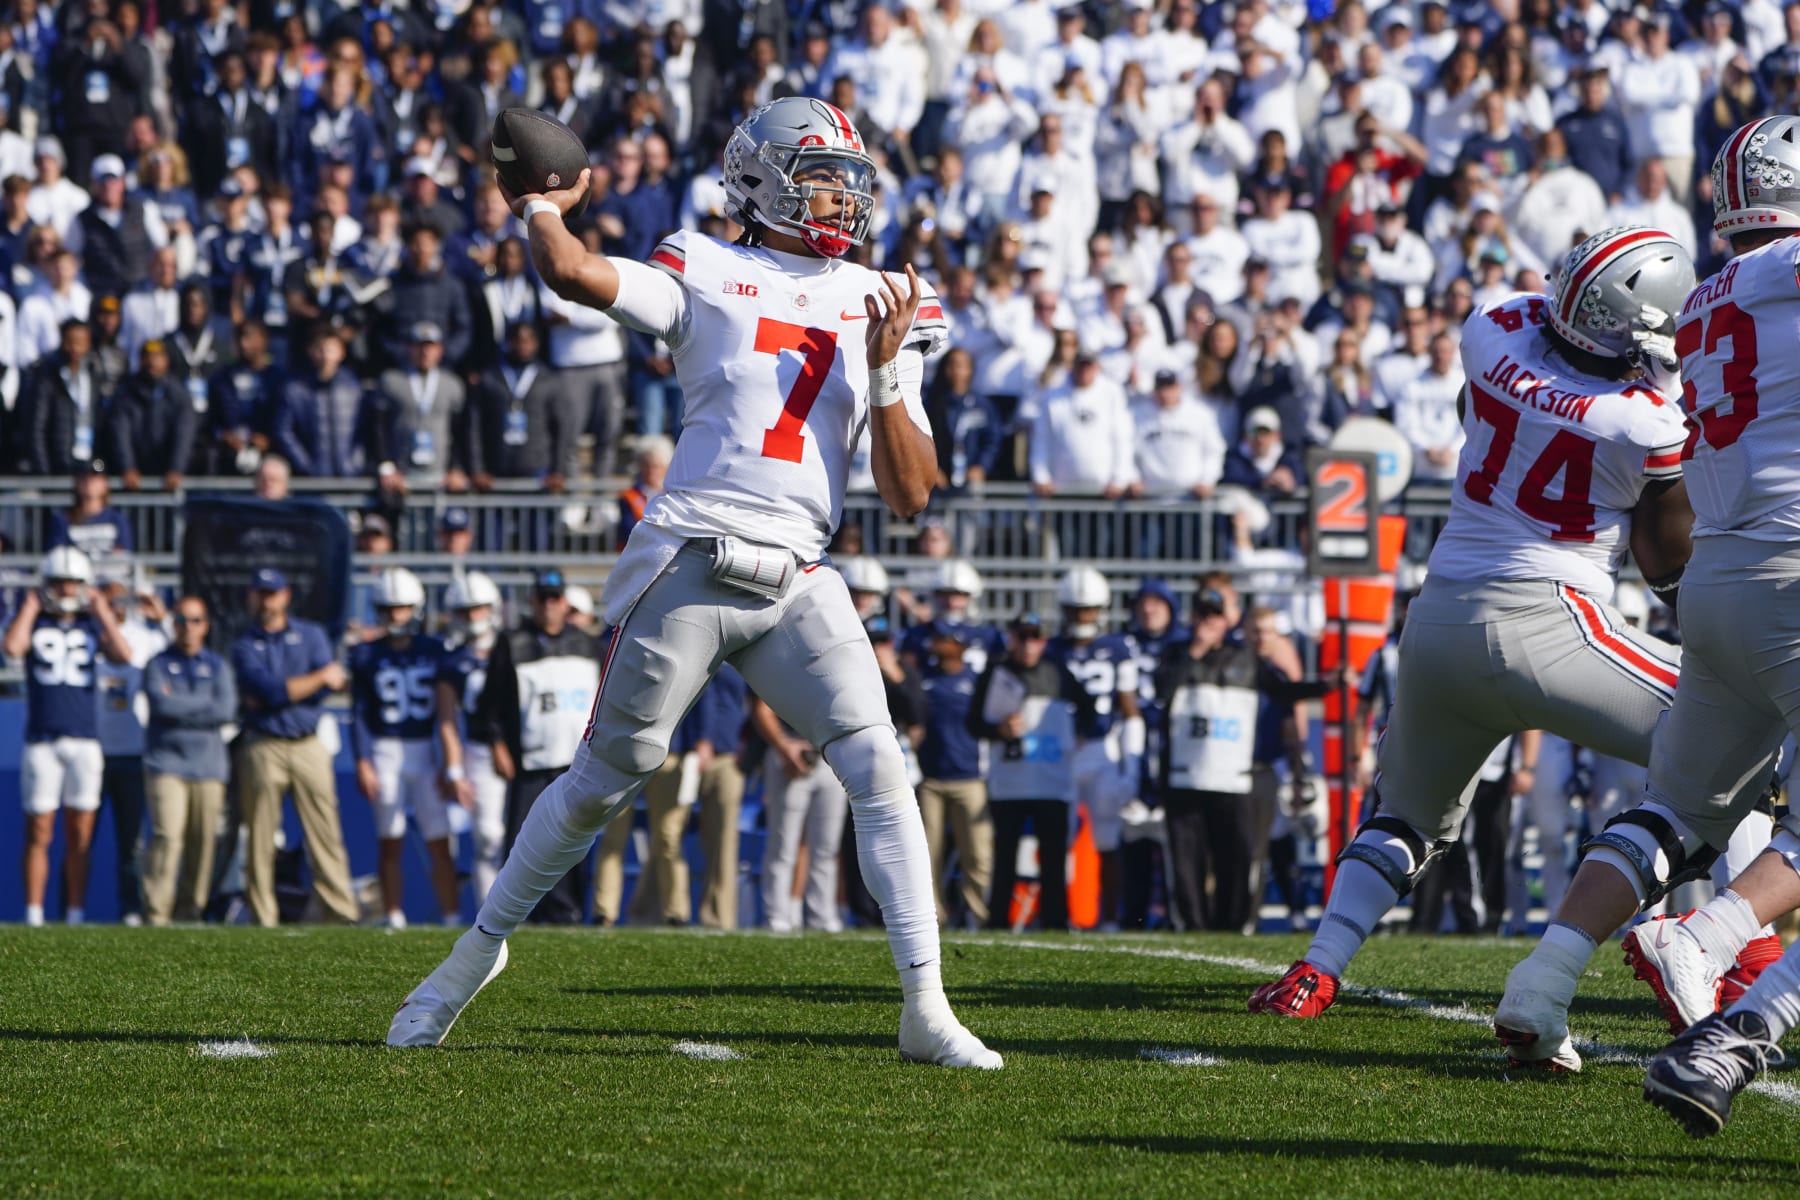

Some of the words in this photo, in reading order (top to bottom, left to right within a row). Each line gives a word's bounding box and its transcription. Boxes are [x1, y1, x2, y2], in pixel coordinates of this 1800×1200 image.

[753, 316, 839, 465] 7
[1483, 355, 1597, 424] JACKSON
[1674, 301, 1759, 461] 53
[1316, 459, 1368, 531] 2
[1464, 379, 1598, 544] 74
[31, 627, 97, 687] 92
[375, 665, 437, 722] 95
